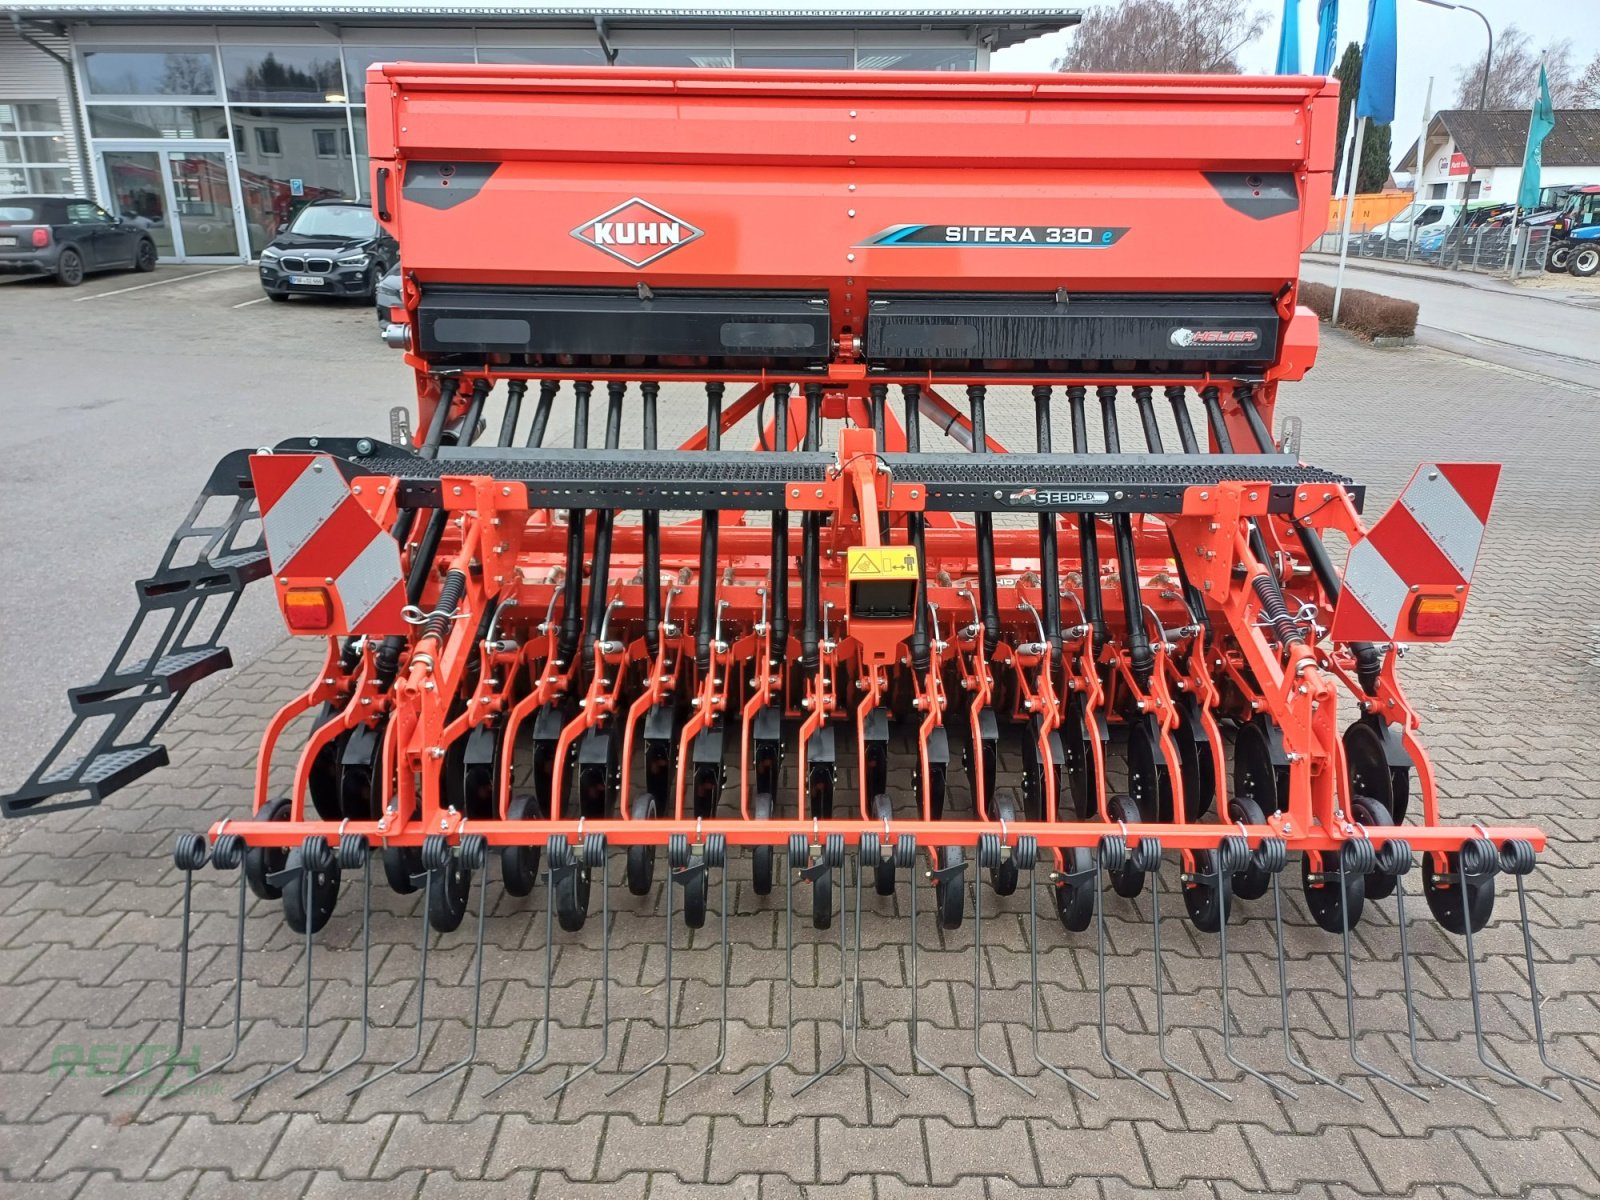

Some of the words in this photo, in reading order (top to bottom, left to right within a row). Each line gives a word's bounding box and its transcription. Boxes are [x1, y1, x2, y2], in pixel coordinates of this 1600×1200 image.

[594, 222, 680, 244] KUHN
[945, 227, 1036, 243] SITERA
[1046, 228, 1093, 243] 330
[1101, 231, 1113, 243] e
[1193, 331, 1256, 342] HELICA
[1035, 492, 1095, 505] SEEDFLEX
